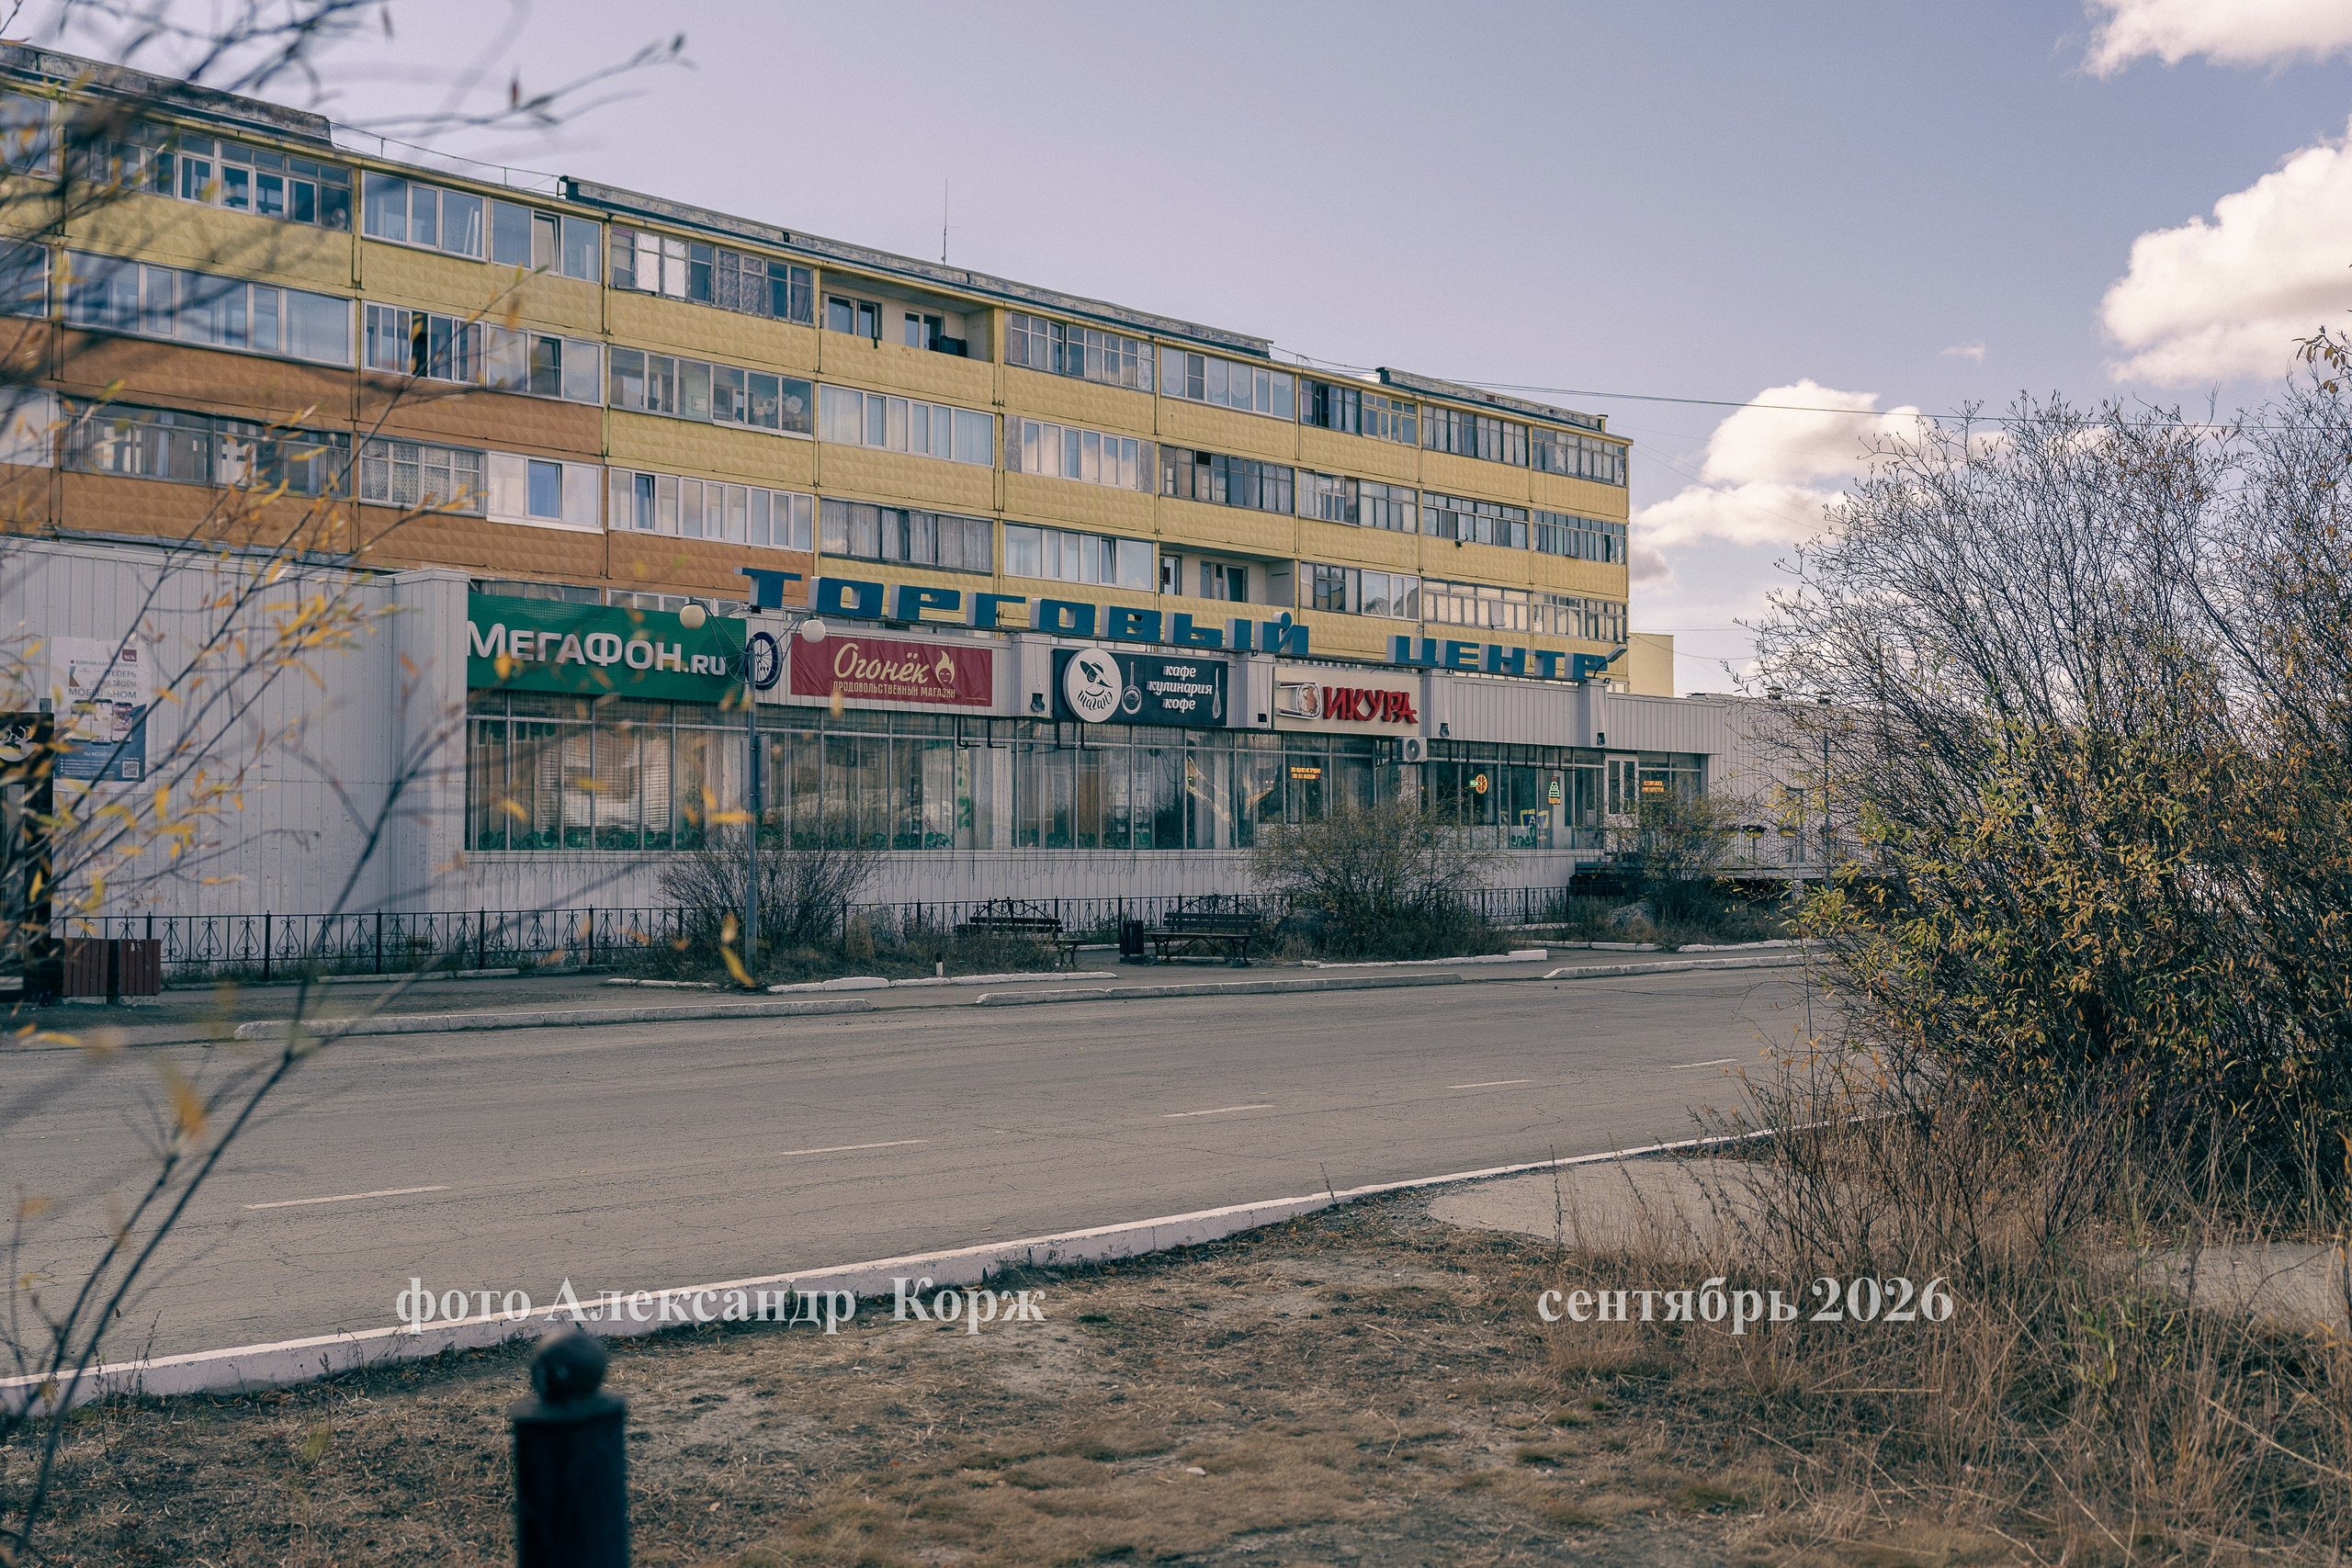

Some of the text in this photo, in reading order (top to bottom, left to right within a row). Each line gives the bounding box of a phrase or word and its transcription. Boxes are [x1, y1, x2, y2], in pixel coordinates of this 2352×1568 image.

[733, 566, 1608, 680] ТОРГОВЫЙ ЦЕНТР
[833, 642, 930, 684] Огонёк
[1162, 665, 1197, 682] кафе
[832, 681, 956, 698] ПРОДОВОЛЬСТВЕННЫЙ МАГАЗИН
[1146, 680, 1213, 698] кулинария
[1162, 697, 1196, 714] кофе
[1322, 686, 1419, 724] ИКУРА
